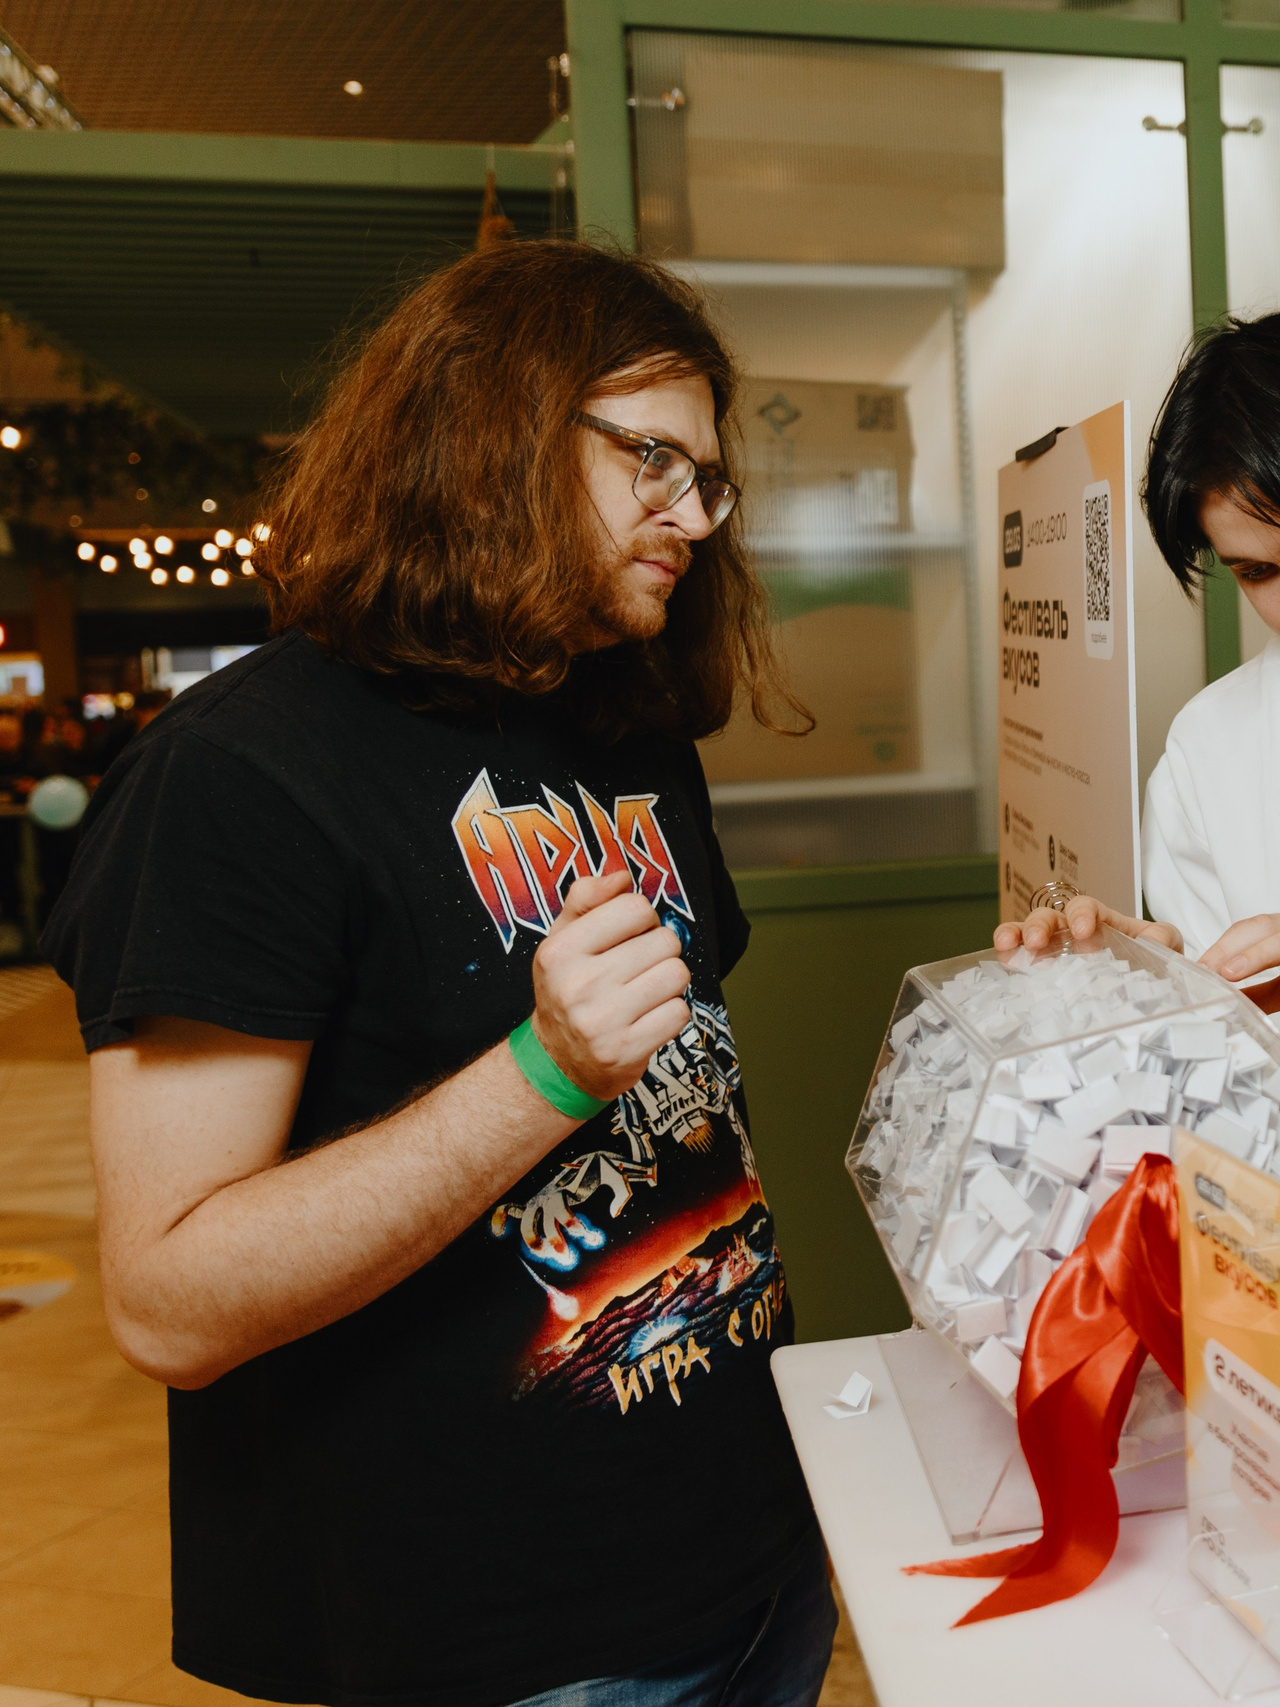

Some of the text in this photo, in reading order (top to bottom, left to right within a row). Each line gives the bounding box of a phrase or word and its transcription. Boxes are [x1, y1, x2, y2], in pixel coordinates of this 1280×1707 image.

[1003, 587, 1069, 640] Фестиваль
[1003, 647, 1040, 694] вкусов
[451, 767, 696, 954] АРИЯ
[1214, 1252, 1278, 1310] вкусов
[607, 1336, 711, 1415] ИГРА
[1214, 1353, 1225, 1379] 2
